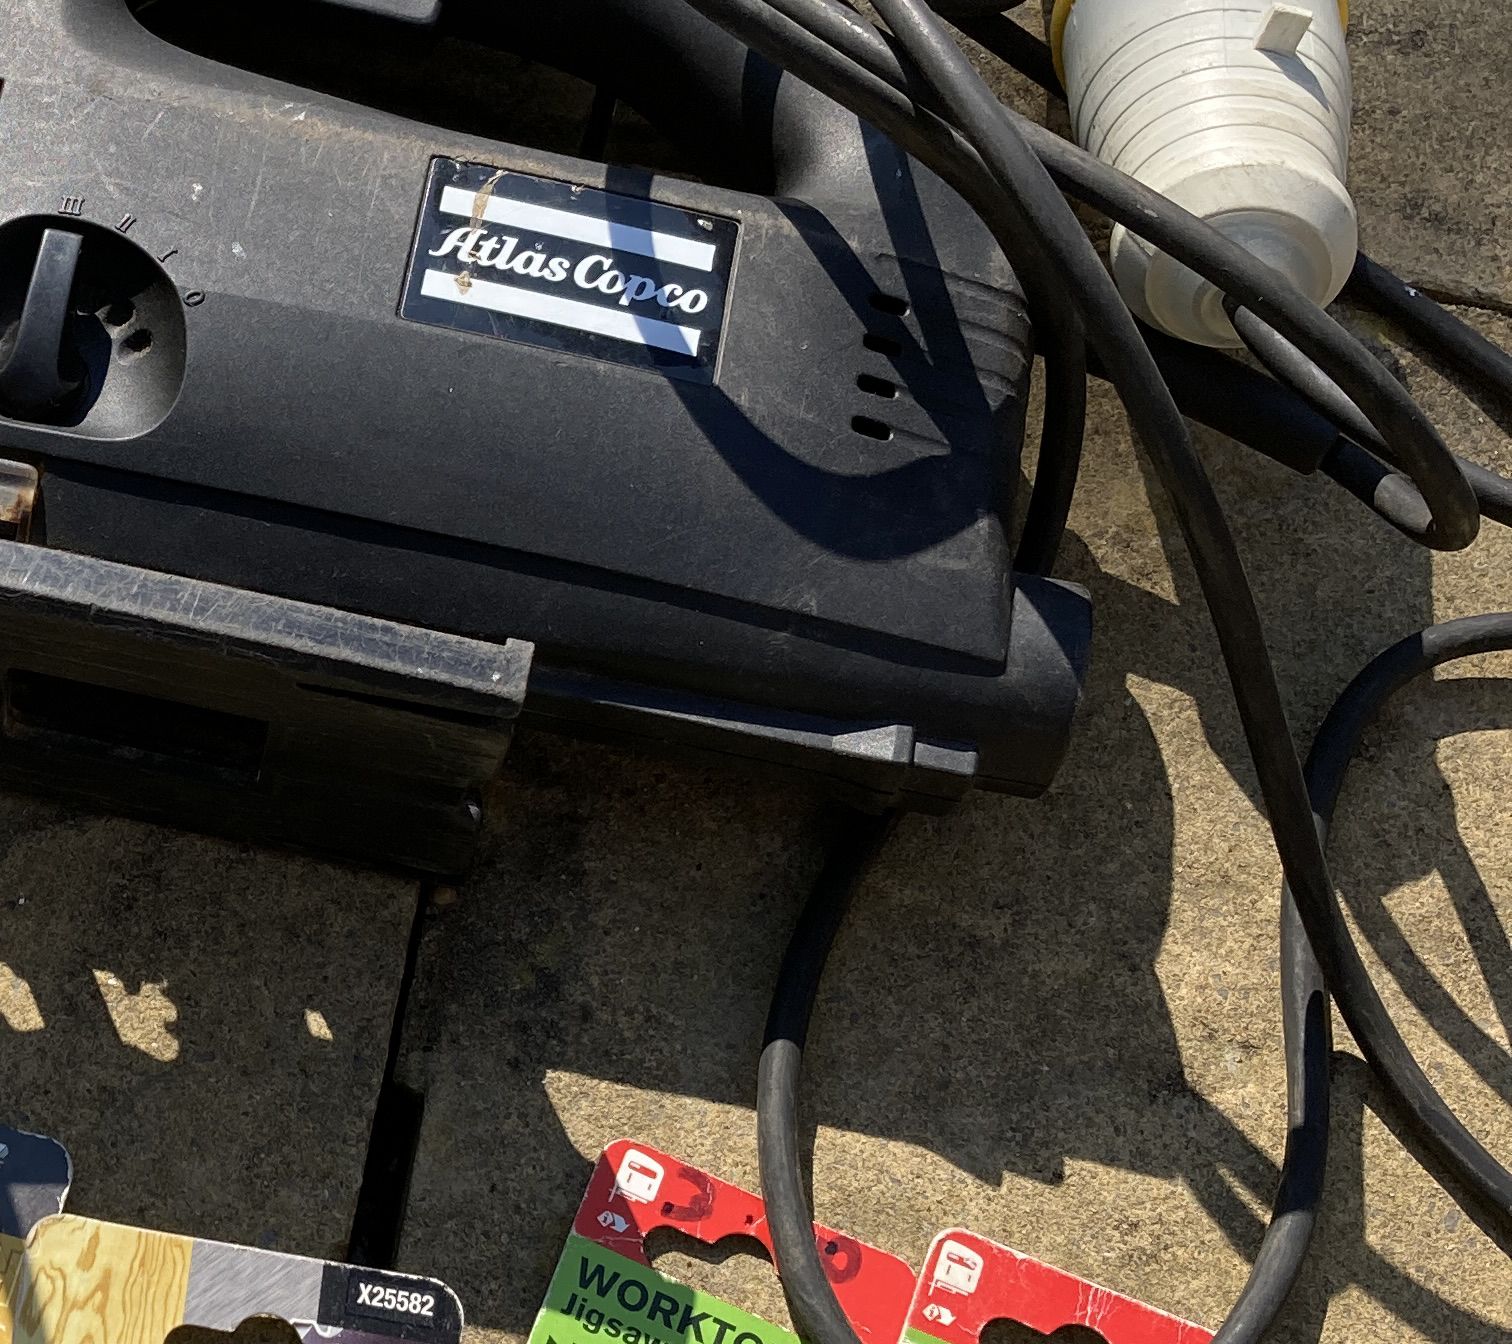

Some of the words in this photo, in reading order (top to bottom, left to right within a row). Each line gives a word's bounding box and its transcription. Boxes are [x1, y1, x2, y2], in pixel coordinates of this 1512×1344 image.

[428, 226, 570, 282] Atlas
[573, 254, 709, 314] Copco
[356, 1282, 435, 1317] X25582
